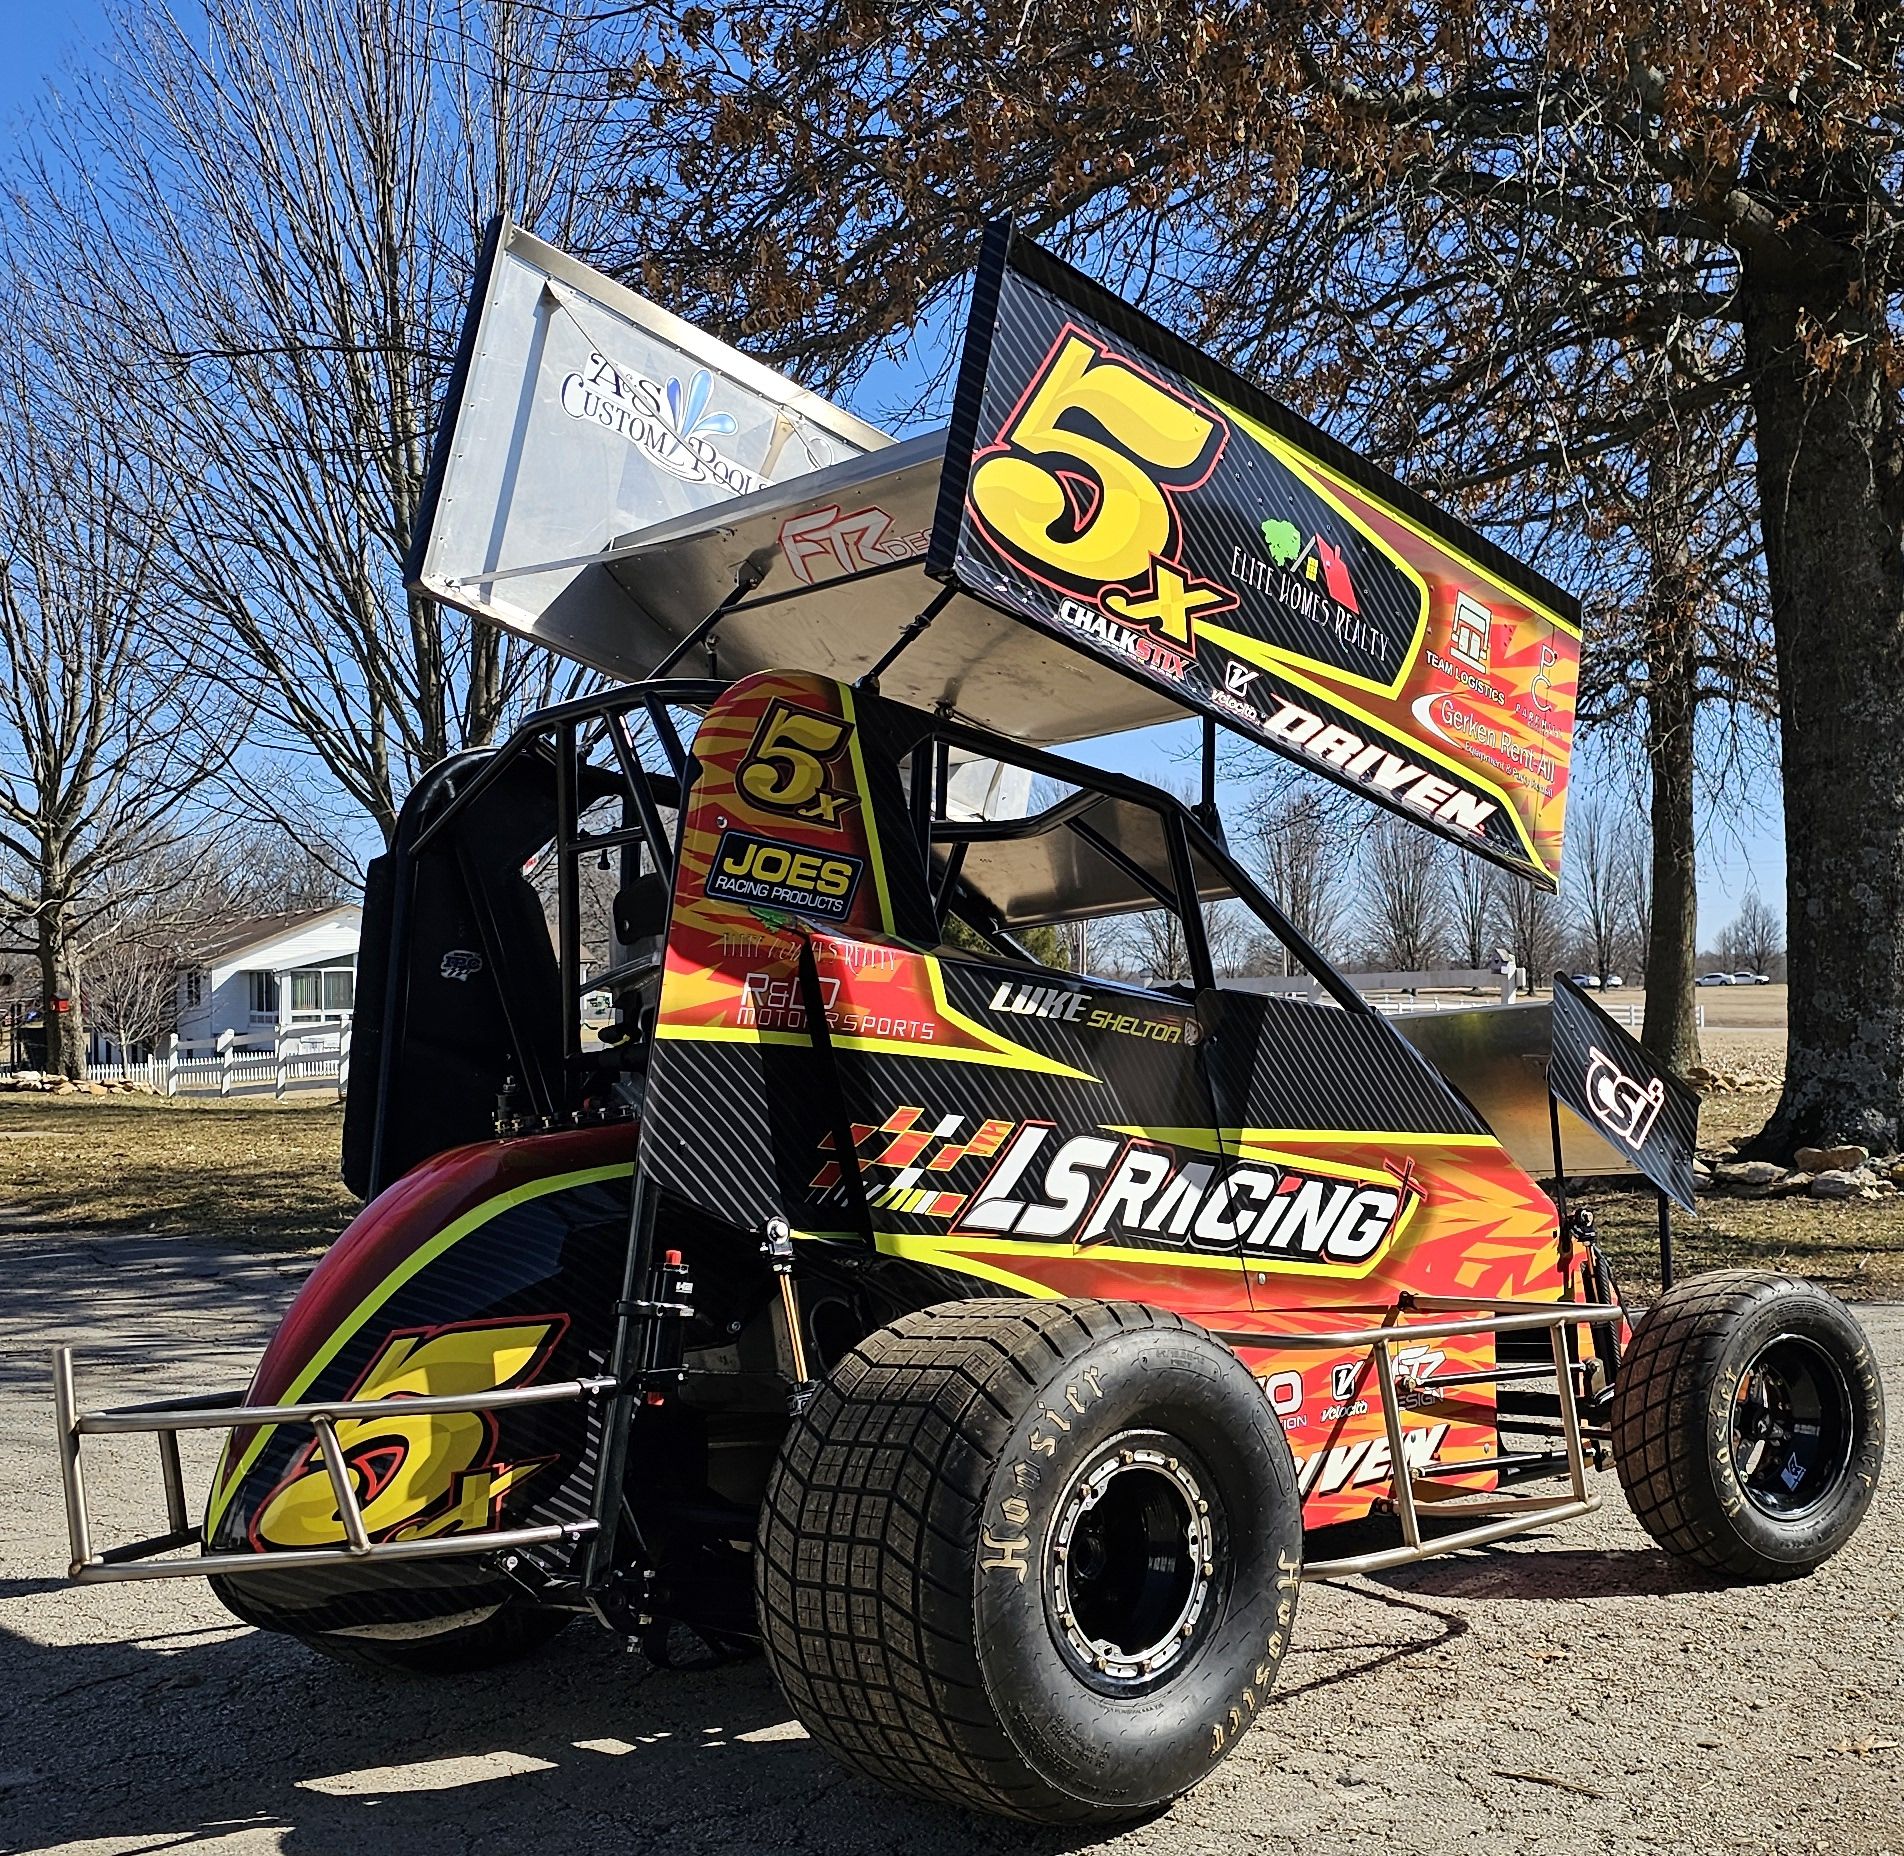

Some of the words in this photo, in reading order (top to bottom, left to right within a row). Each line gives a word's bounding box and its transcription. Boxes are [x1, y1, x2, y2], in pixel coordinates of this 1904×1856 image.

[561, 372, 670, 455] CUSTOM
[1231, 545, 1275, 597] ELITE
[1279, 573, 1330, 627] HOMES
[1335, 605, 1390, 662] REALTY
[1426, 650, 1454, 676] TEAM
[1455, 666, 1506, 706] LOGISTICS
[1441, 699, 1497, 749] Gerken
[1500, 731, 1556, 785] Rent-All
[1464, 742, 1505, 770] Equipment
[715, 875, 770, 898] RACING
[771, 886, 844, 912] PRODUCTS
[723, 843, 853, 896] JOES
[988, 981, 1093, 1023] LUKE
[1086, 1009, 1183, 1044] SHELTON
[978, 1366, 1105, 1585] Hoosier
